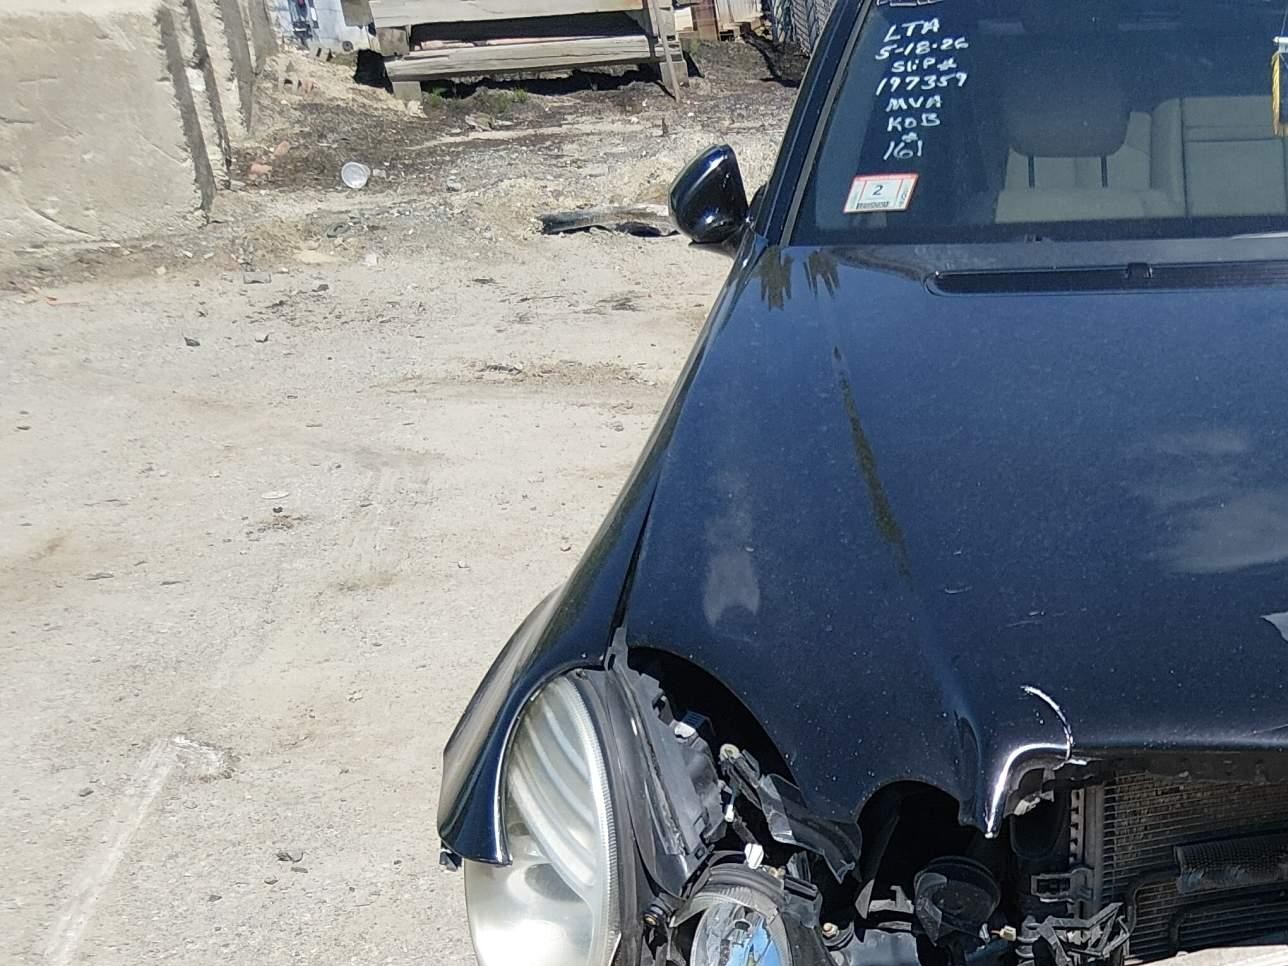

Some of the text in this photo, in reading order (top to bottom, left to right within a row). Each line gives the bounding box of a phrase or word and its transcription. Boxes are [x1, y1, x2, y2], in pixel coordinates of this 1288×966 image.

[883, 17, 940, 43] LTA
[886, 95, 943, 112] MVA
[883, 140, 923, 160] 161
[872, 184, 884, 196] 2
